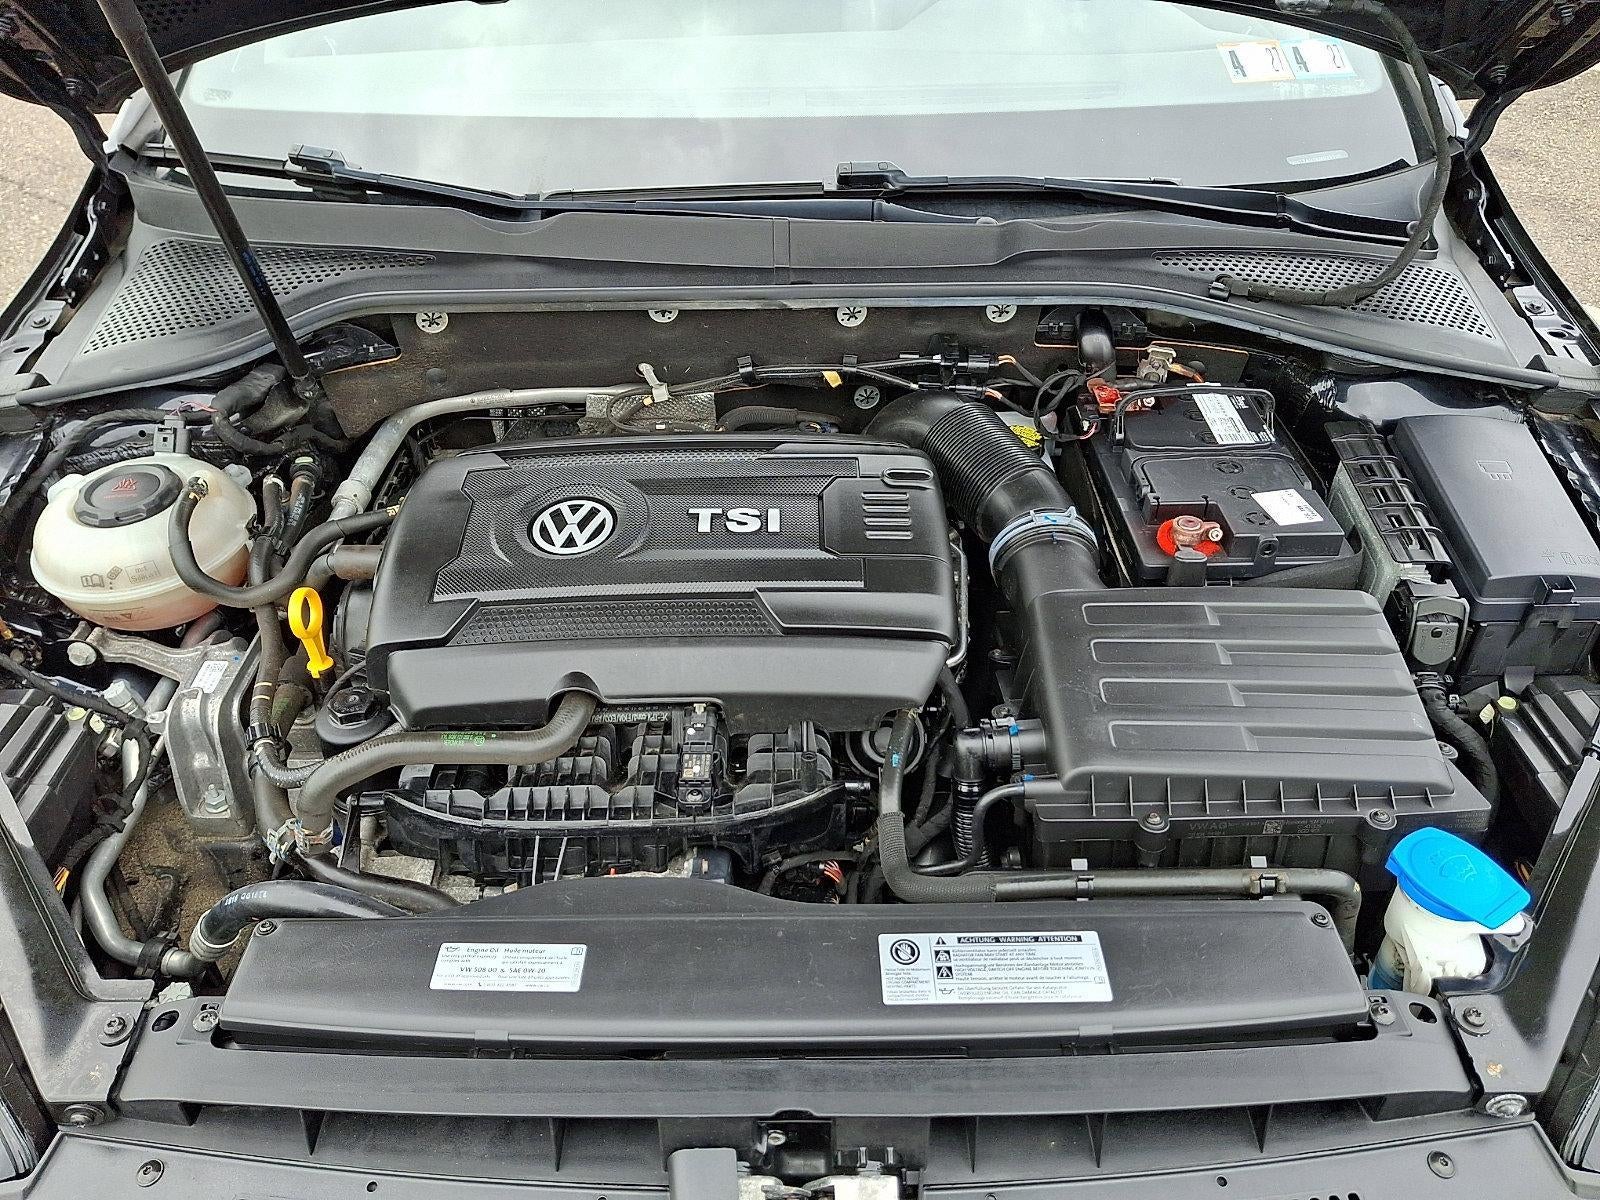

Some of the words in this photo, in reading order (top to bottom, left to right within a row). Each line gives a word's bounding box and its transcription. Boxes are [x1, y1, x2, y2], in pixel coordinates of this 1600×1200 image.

[1229, 50, 1247, 77] 4
[1292, 46, 1310, 72] 4
[688, 508, 781, 533] TSI
[466, 947, 489, 955] Engine
